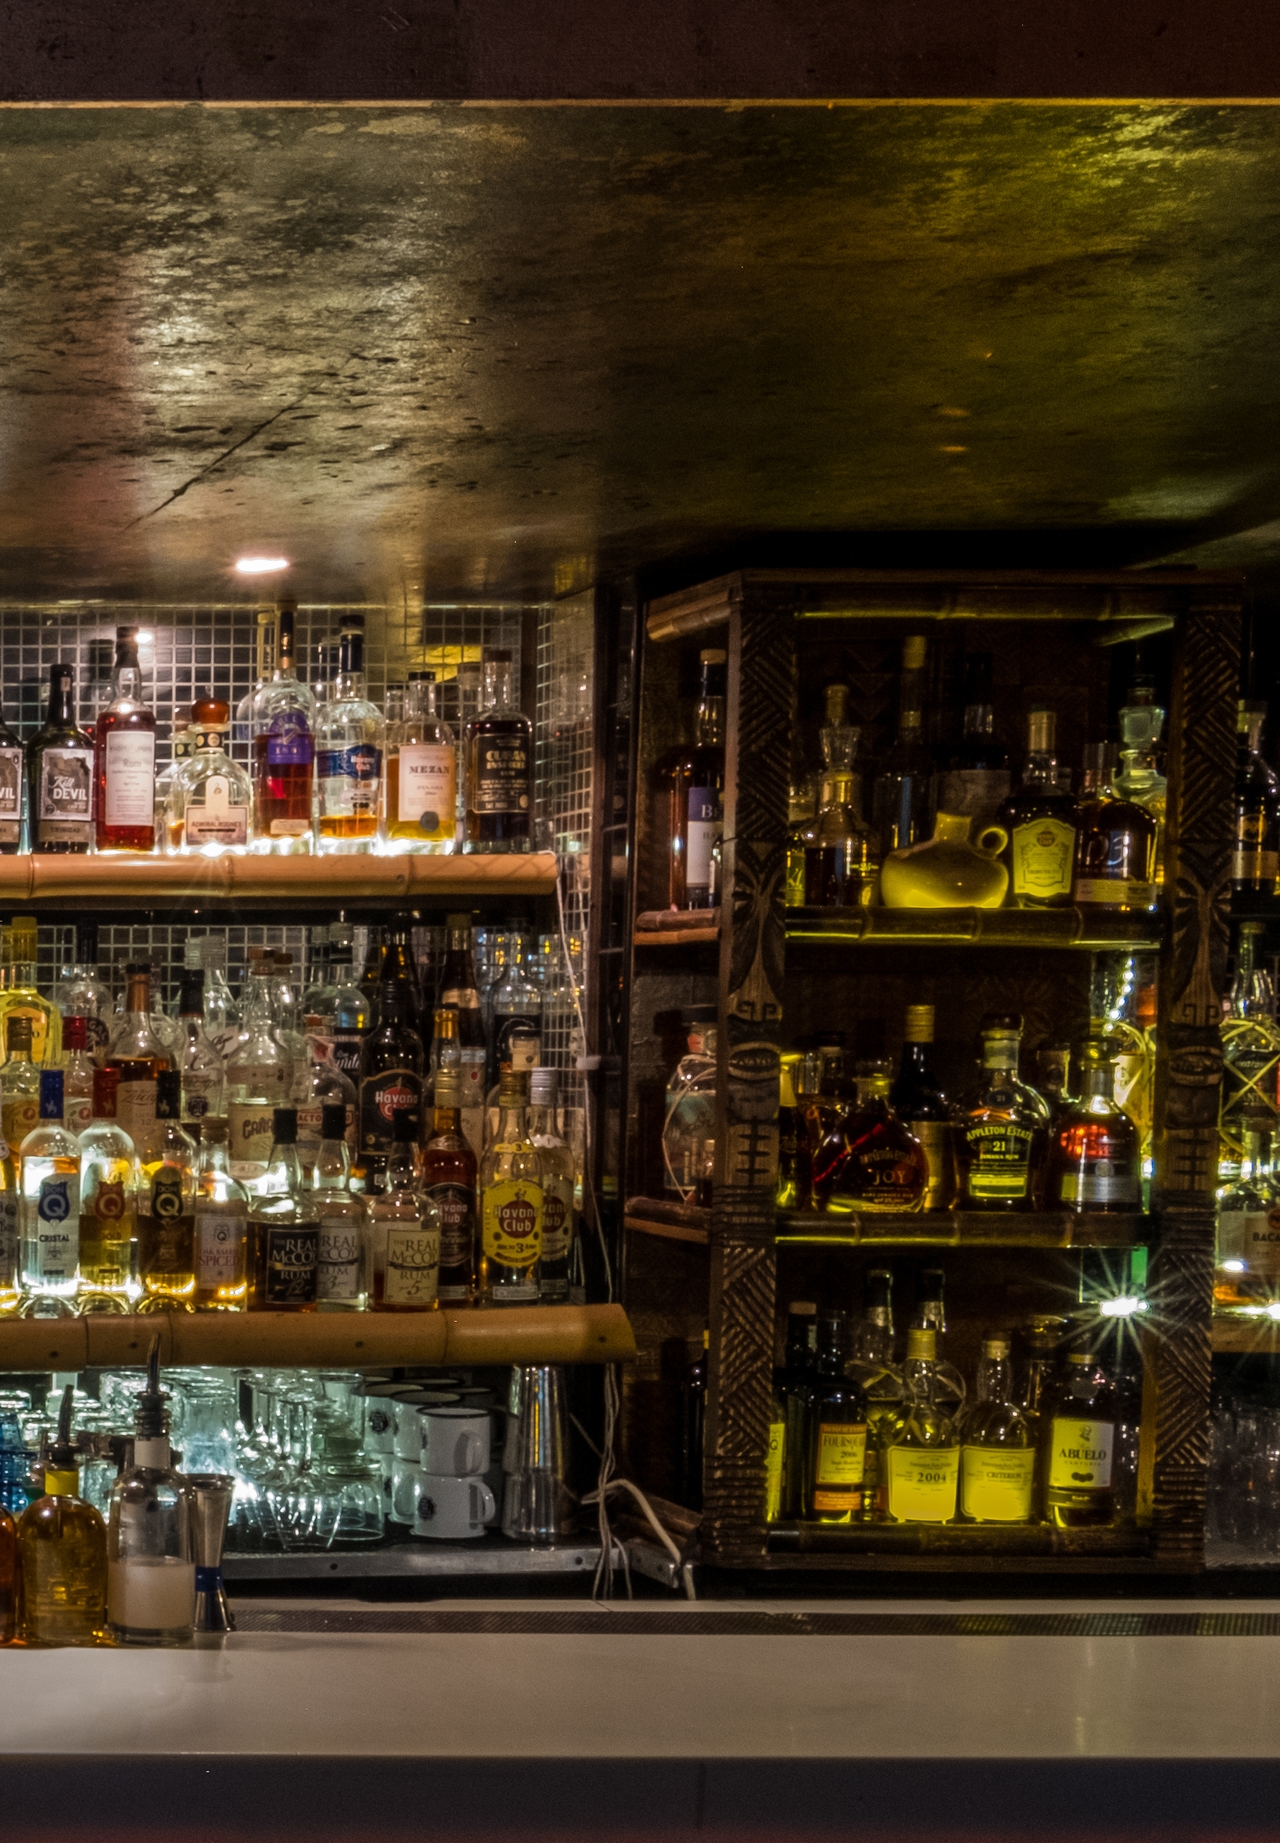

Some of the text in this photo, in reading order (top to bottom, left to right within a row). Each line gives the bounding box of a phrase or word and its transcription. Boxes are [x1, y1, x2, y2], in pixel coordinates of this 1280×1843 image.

[408, 765, 451, 775] MEZAN
[52, 787, 88, 800] DEVIL
[50, 827, 81, 835] TRINIDAD
[374, 1090, 418, 1105] Havana
[966, 1125, 1034, 1141] APPLETON ESTATE
[992, 1140, 1007, 1152] 21
[872, 1169, 907, 1185] JOY
[44, 1185, 65, 1195] DON
[101, 1185, 120, 1194] DON
[157, 1185, 178, 1194] DON
[42, 1194, 67, 1218] Q
[99, 1193, 122, 1216] Q
[155, 1193, 181, 1216] Q
[493, 1205, 539, 1219] Havana
[503, 1218, 532, 1232] Club
[38, 1234, 70, 1244] CRISTAL
[217, 1231, 227, 1242] Q
[321, 1235, 357, 1249] REAL
[285, 1238, 317, 1253] REAL
[404, 1239, 438, 1253] REAL
[515, 1243, 525, 1254] 3
[198, 1255, 236, 1268] SPICED
[272, 1250, 318, 1265] McCOY
[391, 1251, 438, 1266] McCOY
[281, 1269, 311, 1281] RUM
[327, 1274, 338, 1287] 3
[400, 1270, 431, 1281] RUM
[409, 1279, 421, 1297] 5
[1058, 1447, 1106, 1460] ABUELO
[917, 1471, 947, 1483] 2004
[985, 1471, 1023, 1480] CRITERION
